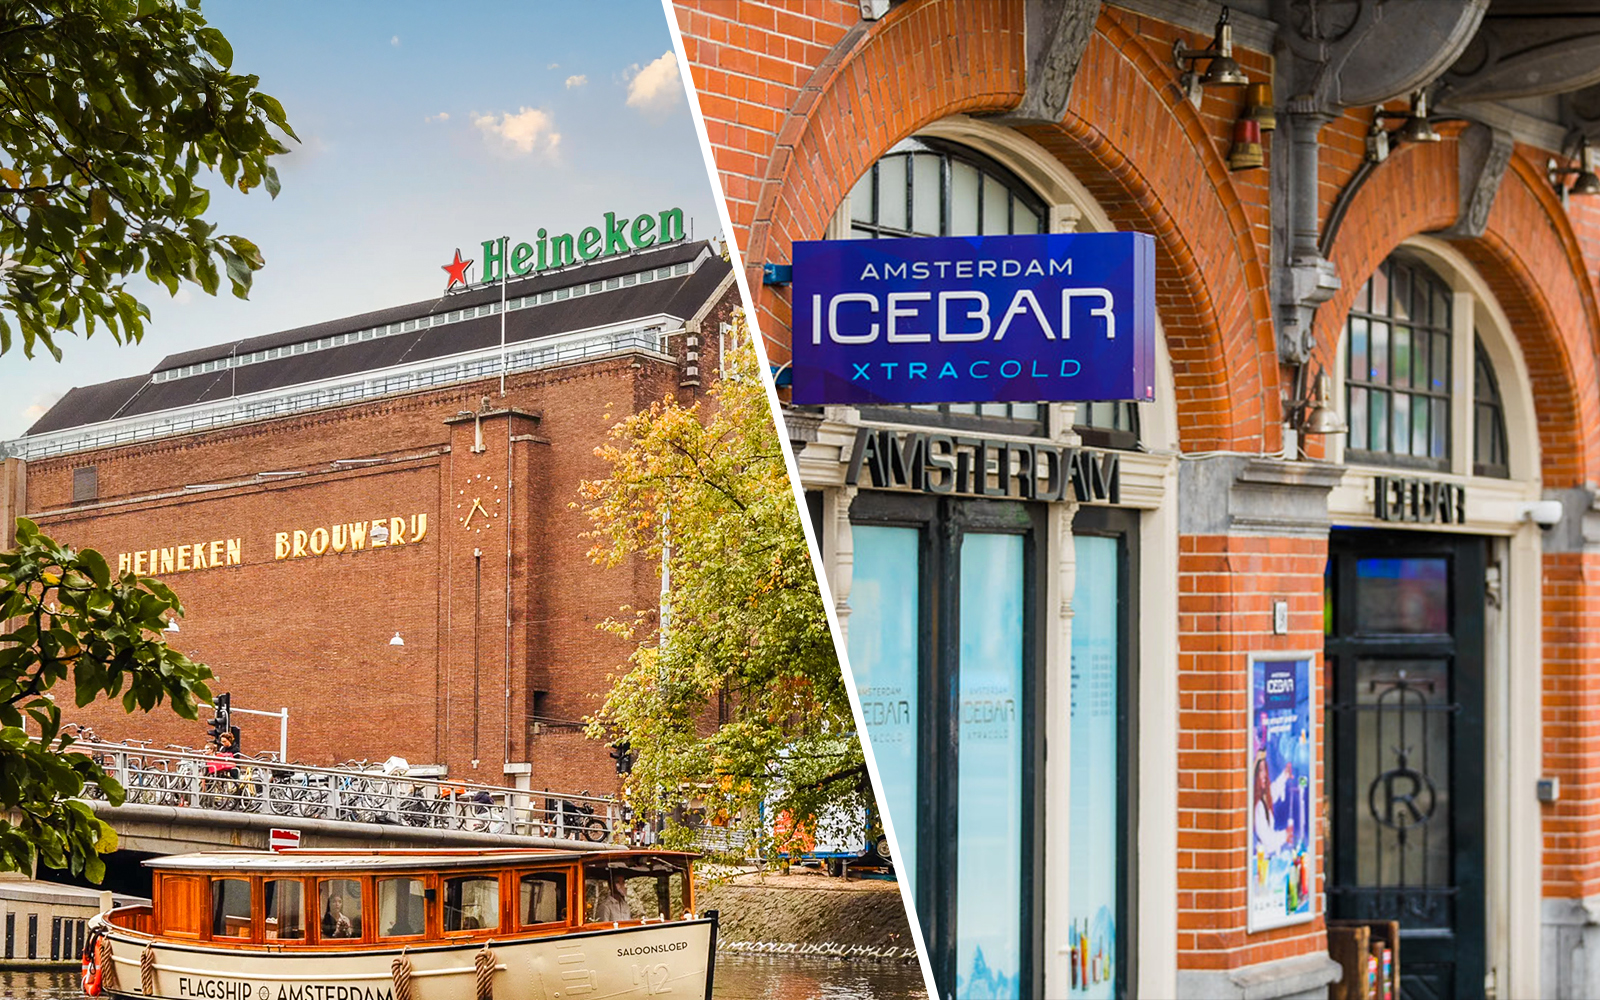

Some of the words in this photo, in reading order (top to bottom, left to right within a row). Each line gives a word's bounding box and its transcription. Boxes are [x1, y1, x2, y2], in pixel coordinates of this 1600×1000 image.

[481, 207, 687, 283] Heineken
[860, 258, 1073, 281] AMSTERDAM
[812, 288, 1116, 345] ICEBAR
[852, 359, 1082, 381] XTRACOLD
[846, 427, 1120, 504] AMSTERDAM
[1374, 474, 1466, 524] ICEBAR
[118, 538, 242, 577] HEINEKEN
[863, 700, 910, 726] EBAR
[617, 941, 688, 957] SALOONSLOEP
[179, 977, 252, 1000] FLAGSHIP
[277, 983, 394, 1000] AMSTERDAM
